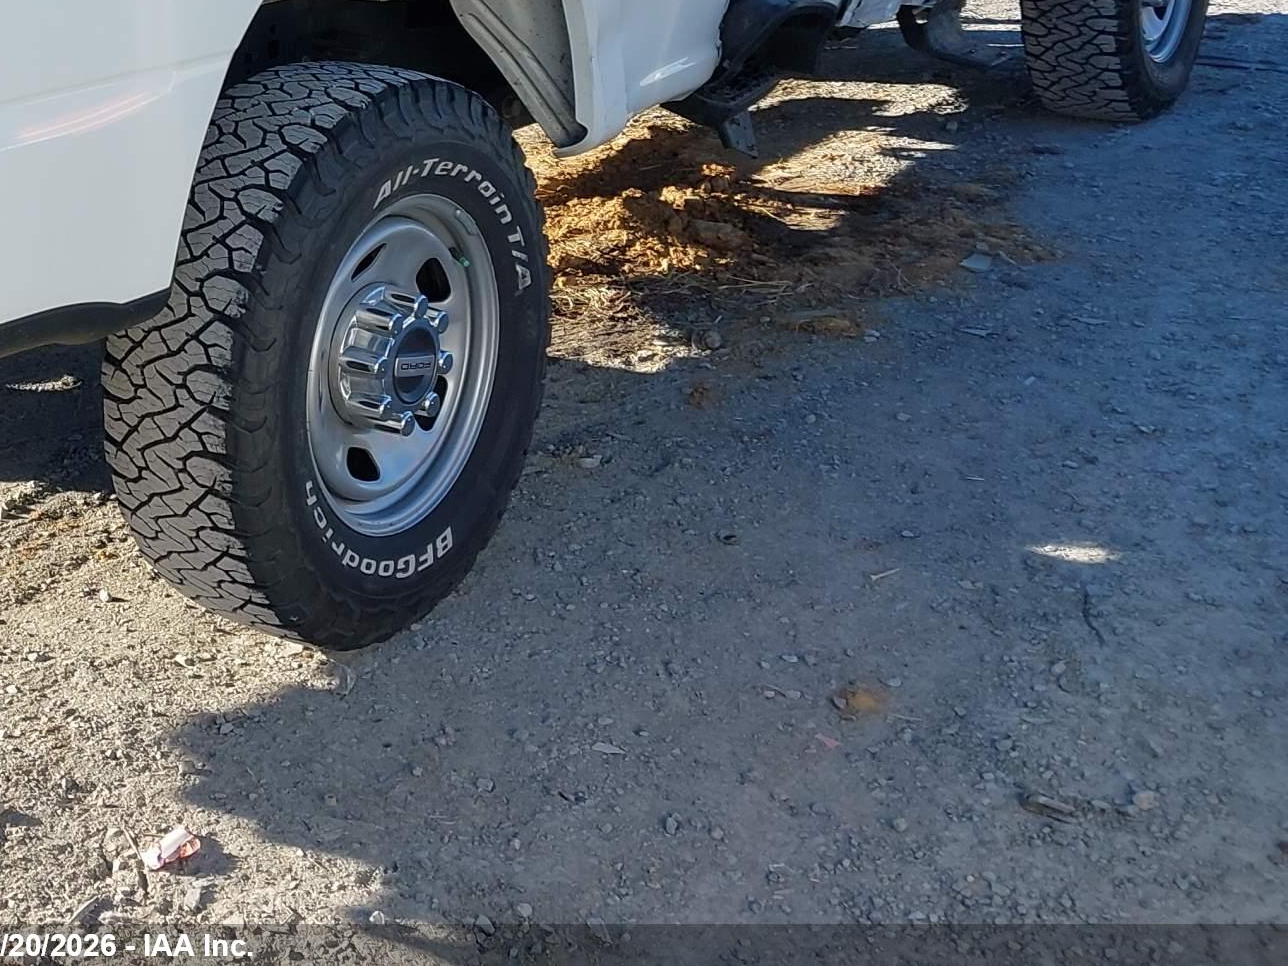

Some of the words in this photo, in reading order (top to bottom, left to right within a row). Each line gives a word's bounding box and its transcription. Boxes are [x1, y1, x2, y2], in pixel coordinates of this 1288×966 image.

[373, 158, 513, 225] All-Terrain
[508, 225, 532, 291] T/A
[401, 362, 431, 370] FORD
[305, 480, 453, 579] BFGoodrich
